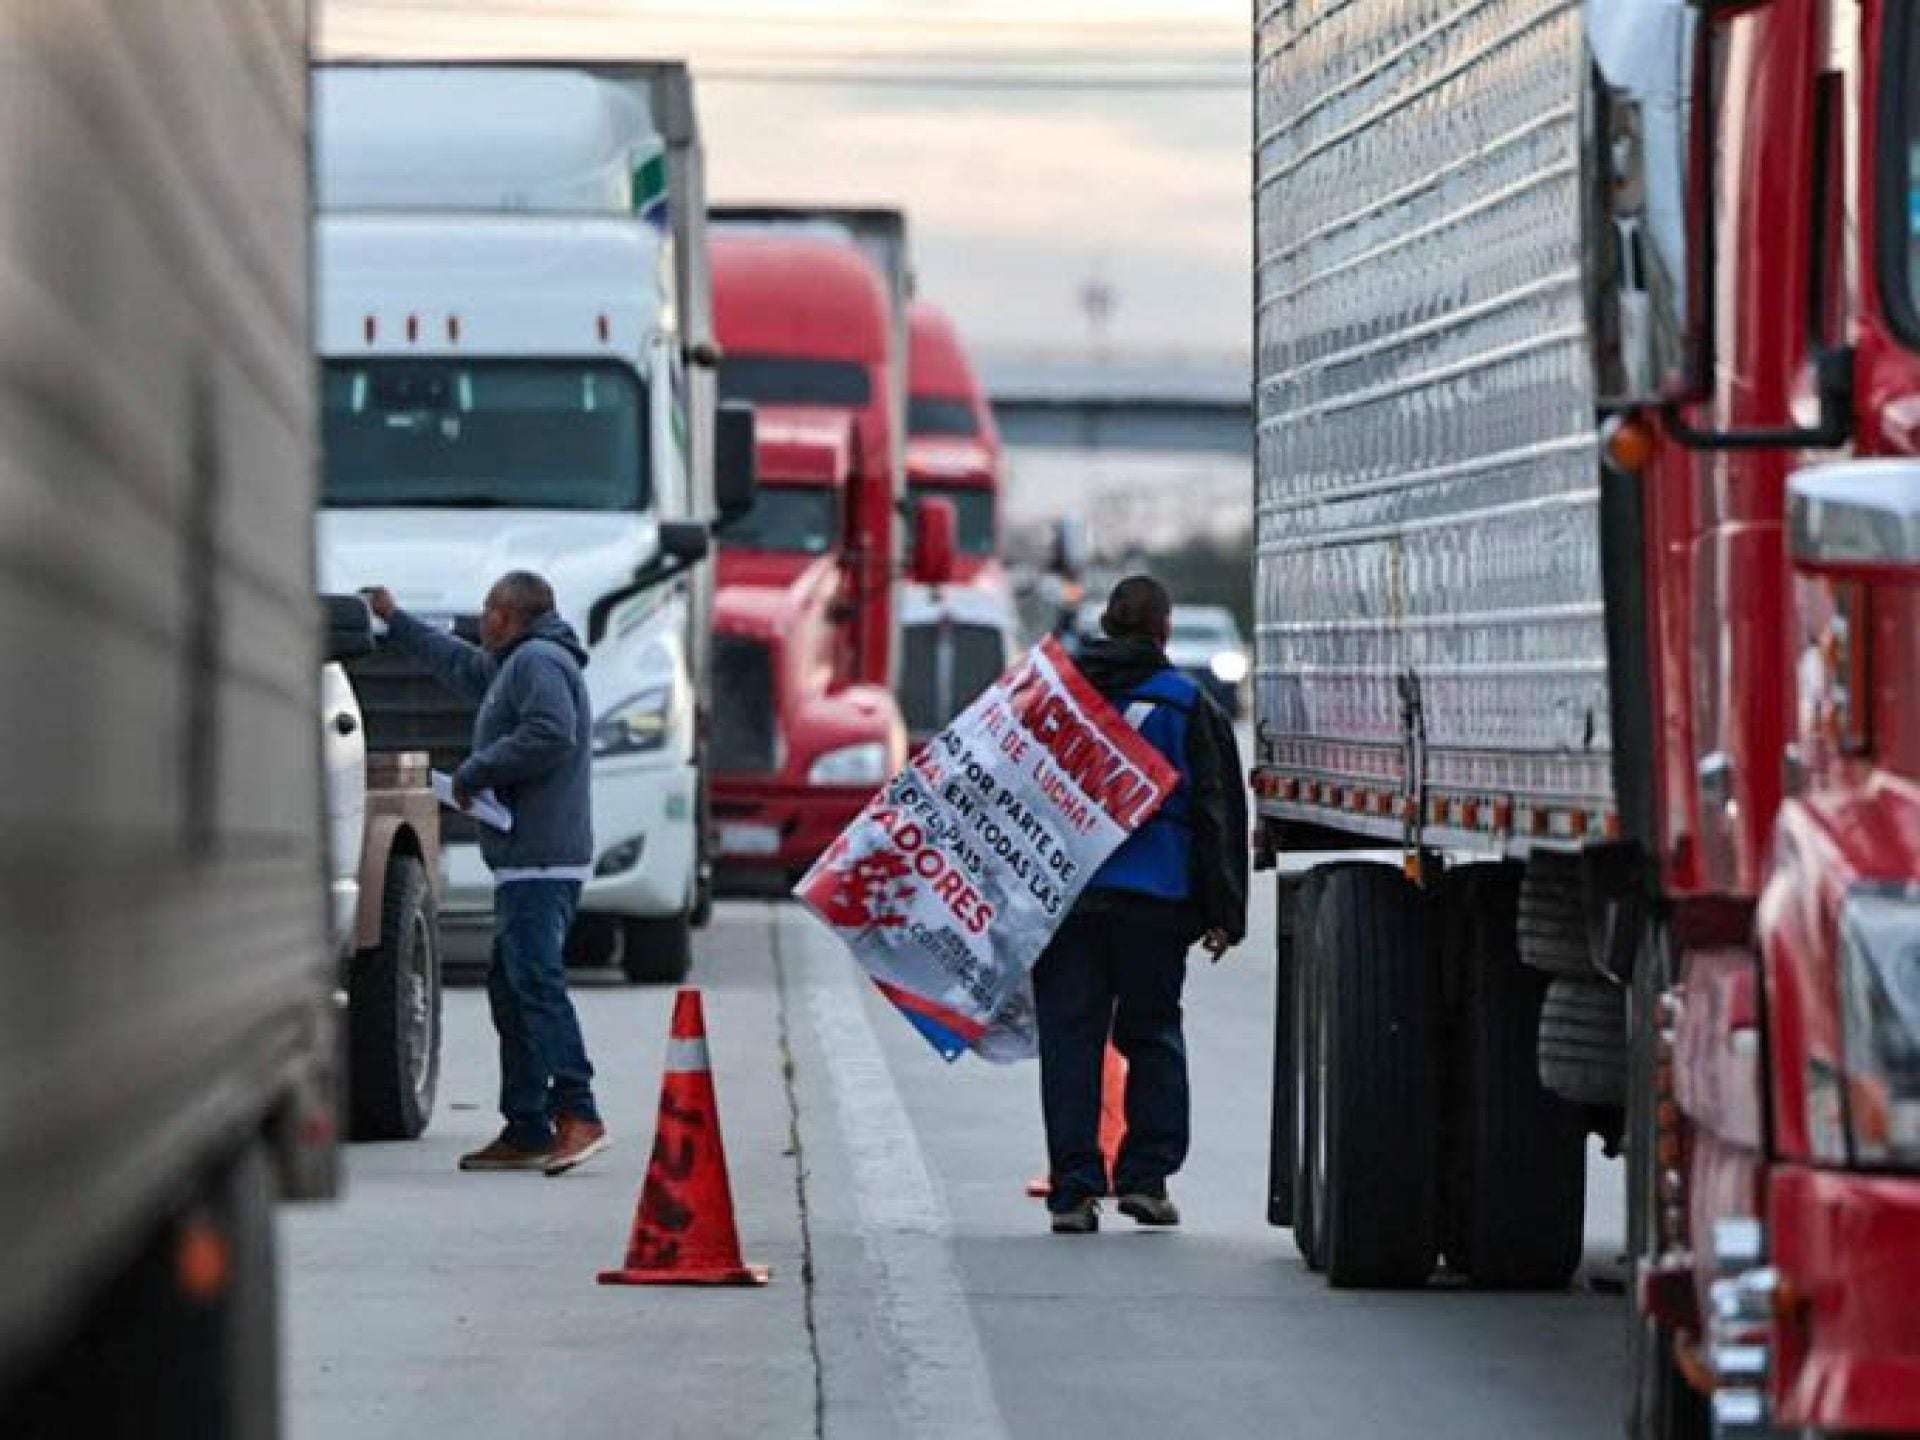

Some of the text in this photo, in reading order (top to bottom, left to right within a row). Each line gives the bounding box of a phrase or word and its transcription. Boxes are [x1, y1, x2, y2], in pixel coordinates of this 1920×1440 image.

[1000, 730, 1029, 763] DE
[944, 783, 974, 816] EN
[973, 814, 1031, 877] TODAS
[1029, 874, 1062, 914] LAS
[995, 789, 1054, 854] PARTE
[1047, 849, 1076, 881] DE
